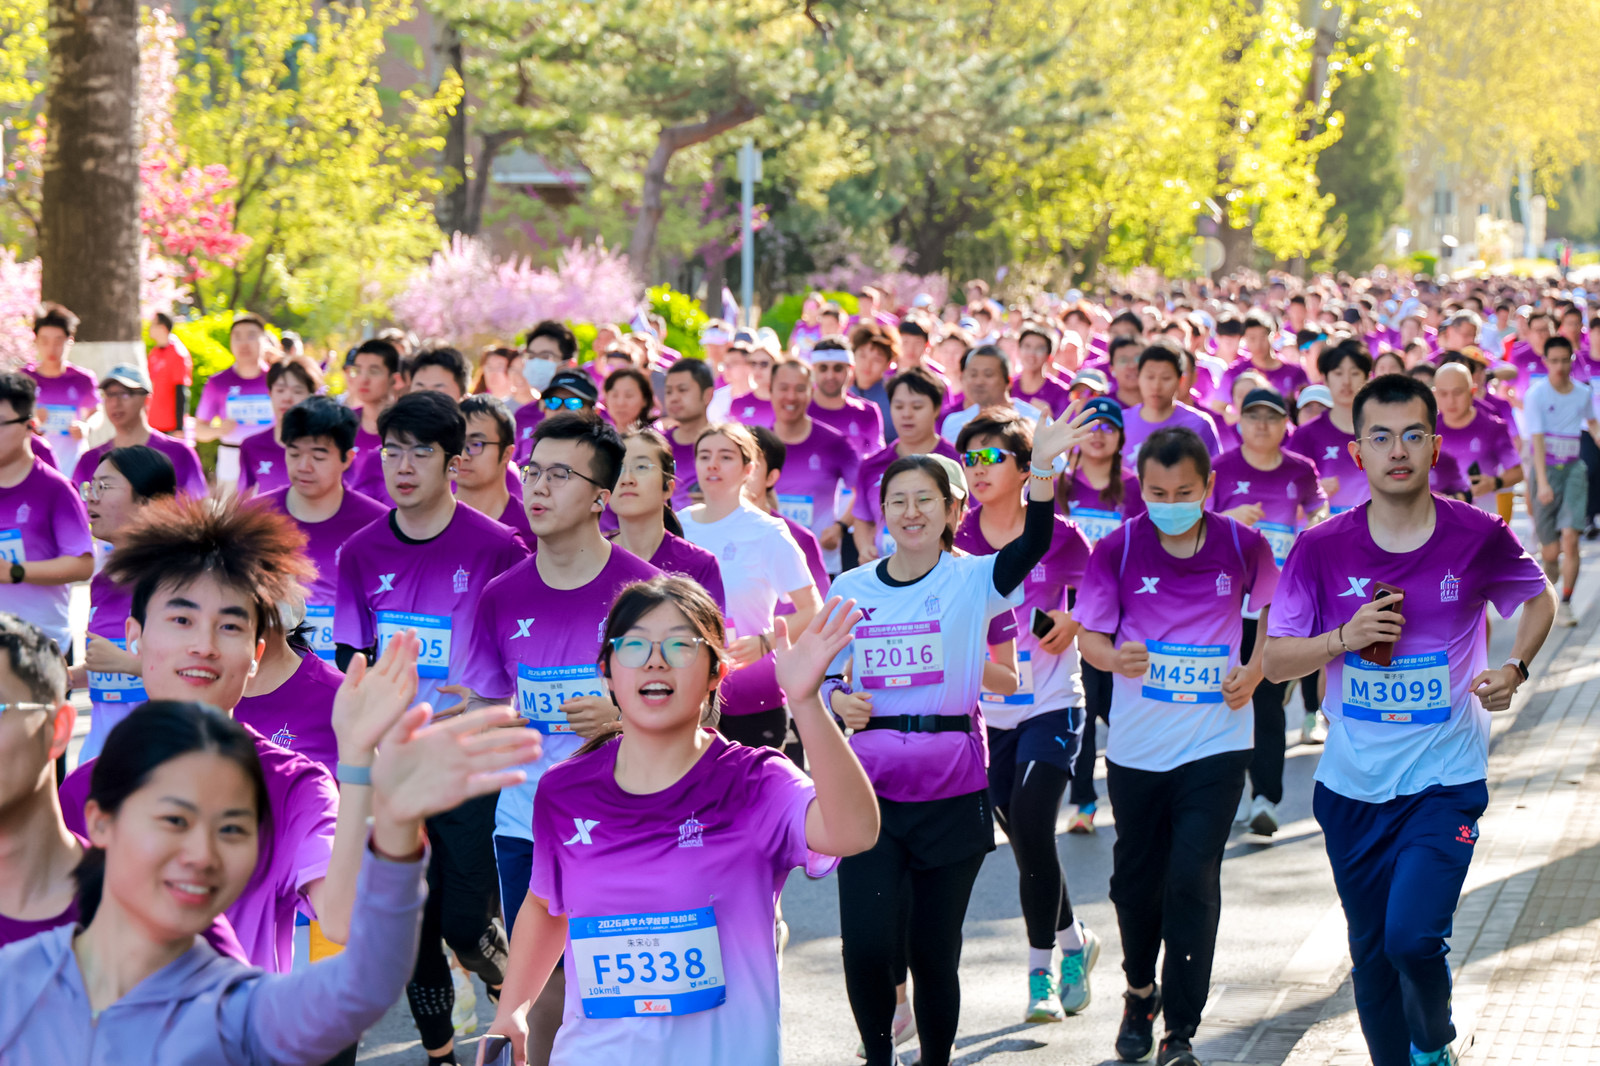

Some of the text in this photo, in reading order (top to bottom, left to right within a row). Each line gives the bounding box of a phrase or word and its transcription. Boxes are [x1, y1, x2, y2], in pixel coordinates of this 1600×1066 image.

[864, 644, 933, 668] F2016
[1150, 663, 1221, 685] M4541
[522, 689, 602, 713] M31
[1350, 678, 1442, 702] M3099
[592, 947, 706, 985] F5338
[589, 986, 621, 995] 10km组
